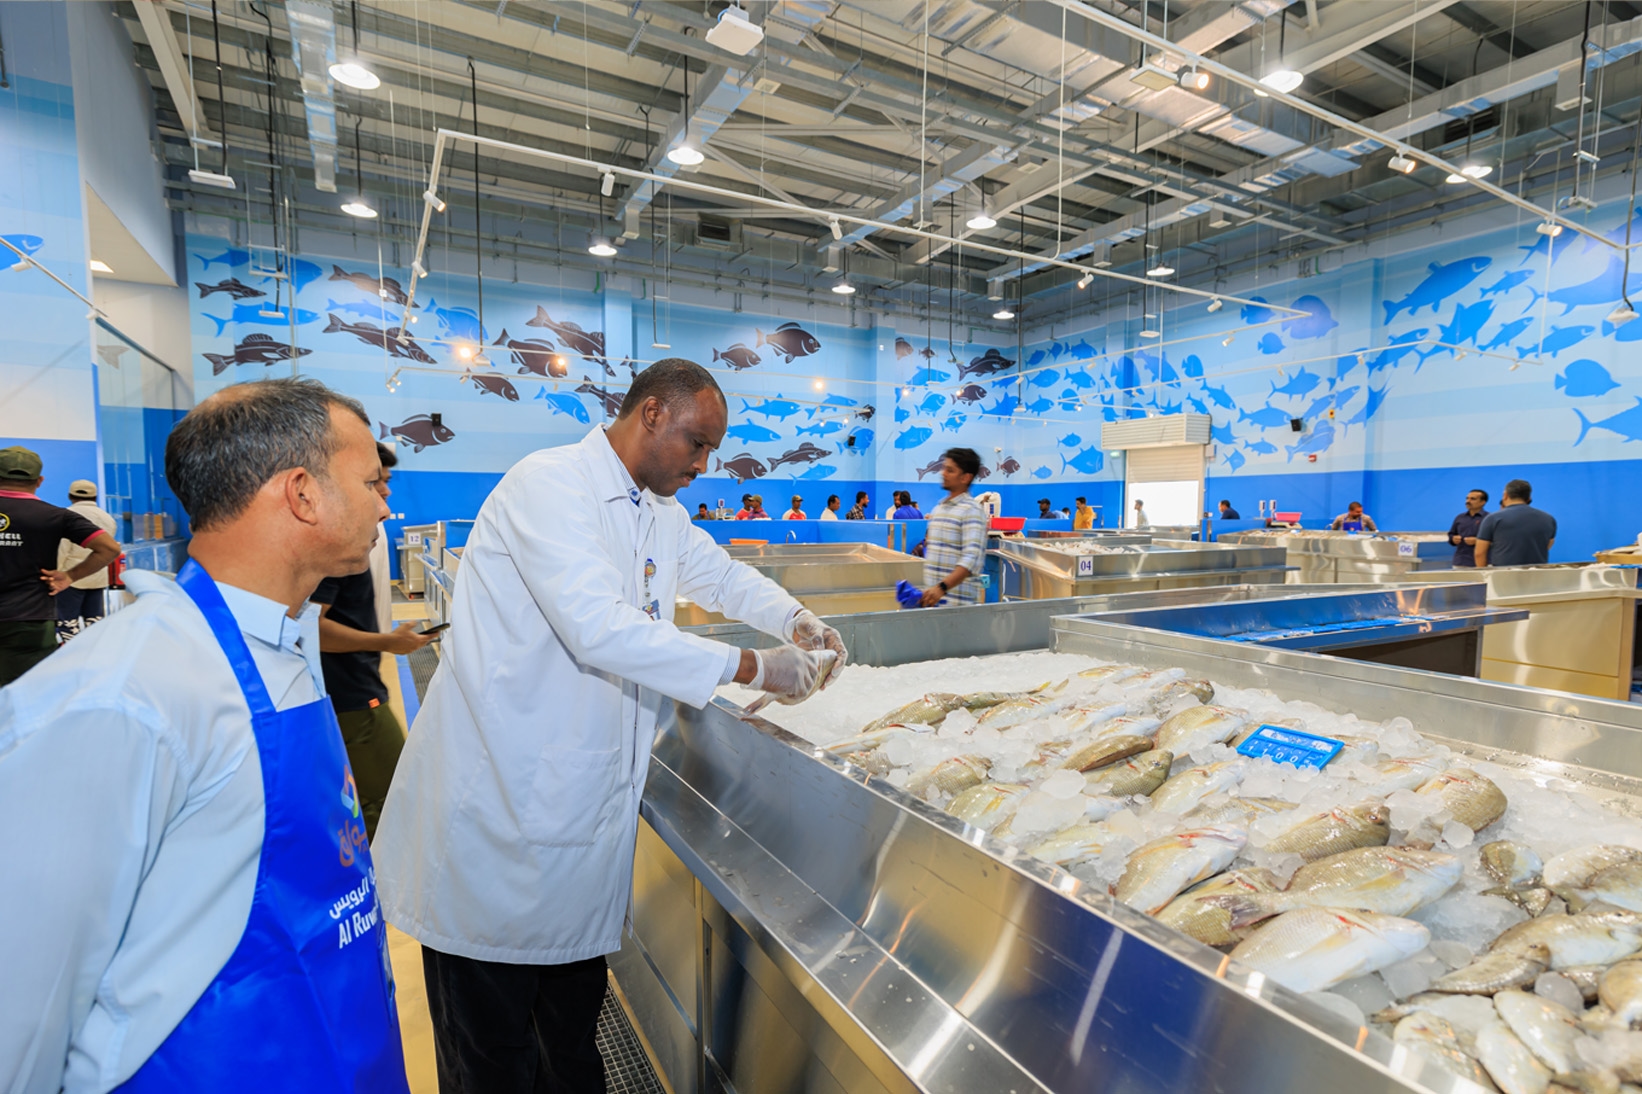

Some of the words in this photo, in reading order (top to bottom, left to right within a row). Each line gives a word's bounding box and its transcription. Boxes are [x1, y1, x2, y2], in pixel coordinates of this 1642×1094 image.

[1080, 560, 1091, 571] 04
[329, 876, 370, 920] الرويس
[339, 918, 353, 949] Al
